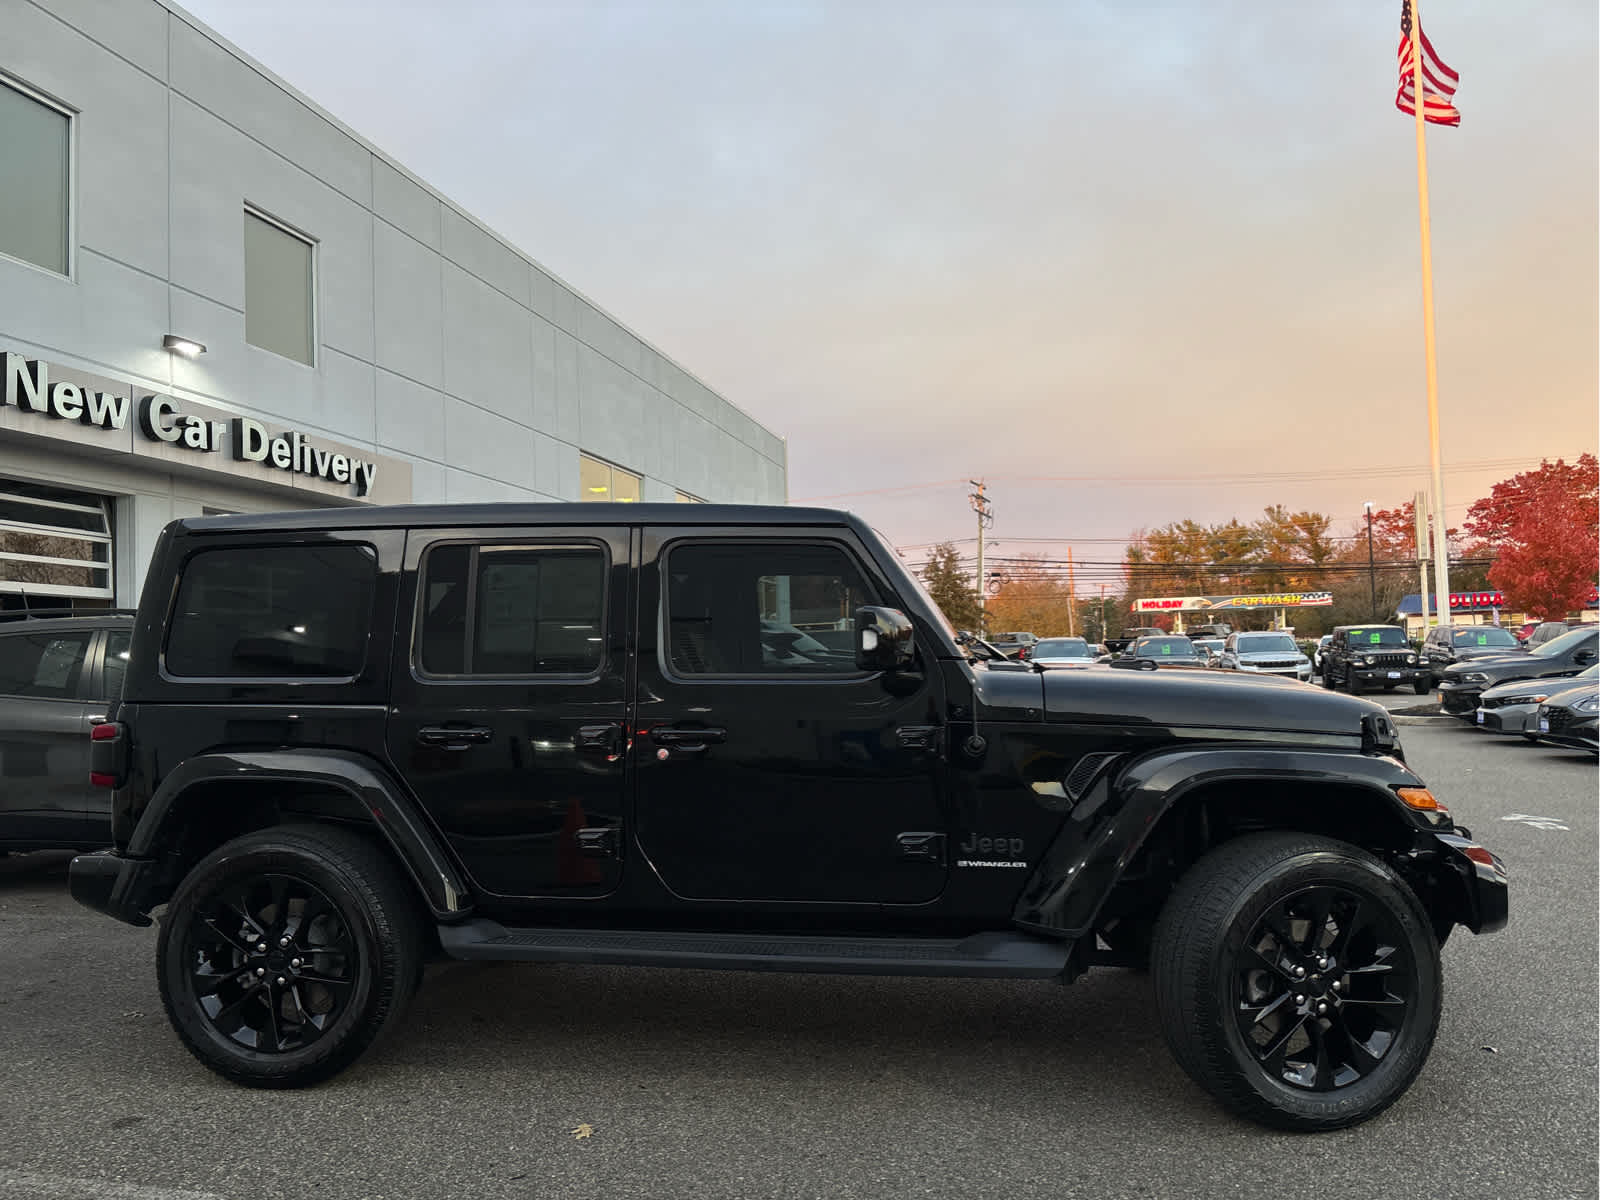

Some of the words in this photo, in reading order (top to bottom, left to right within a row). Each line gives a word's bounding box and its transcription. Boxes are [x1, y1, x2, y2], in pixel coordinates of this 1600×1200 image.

[2, 352, 130, 431] New
[140, 394, 227, 452] Car
[233, 417, 377, 497] Delivery
[1142, 600, 1184, 609] HOLIDAY
[1232, 597, 1258, 606] CAR
[1262, 595, 1301, 605] WASH
[1434, 592, 1505, 608] OLIDA
[960, 832, 1024, 857] Jeep
[967, 860, 1027, 868] WRANGLER
